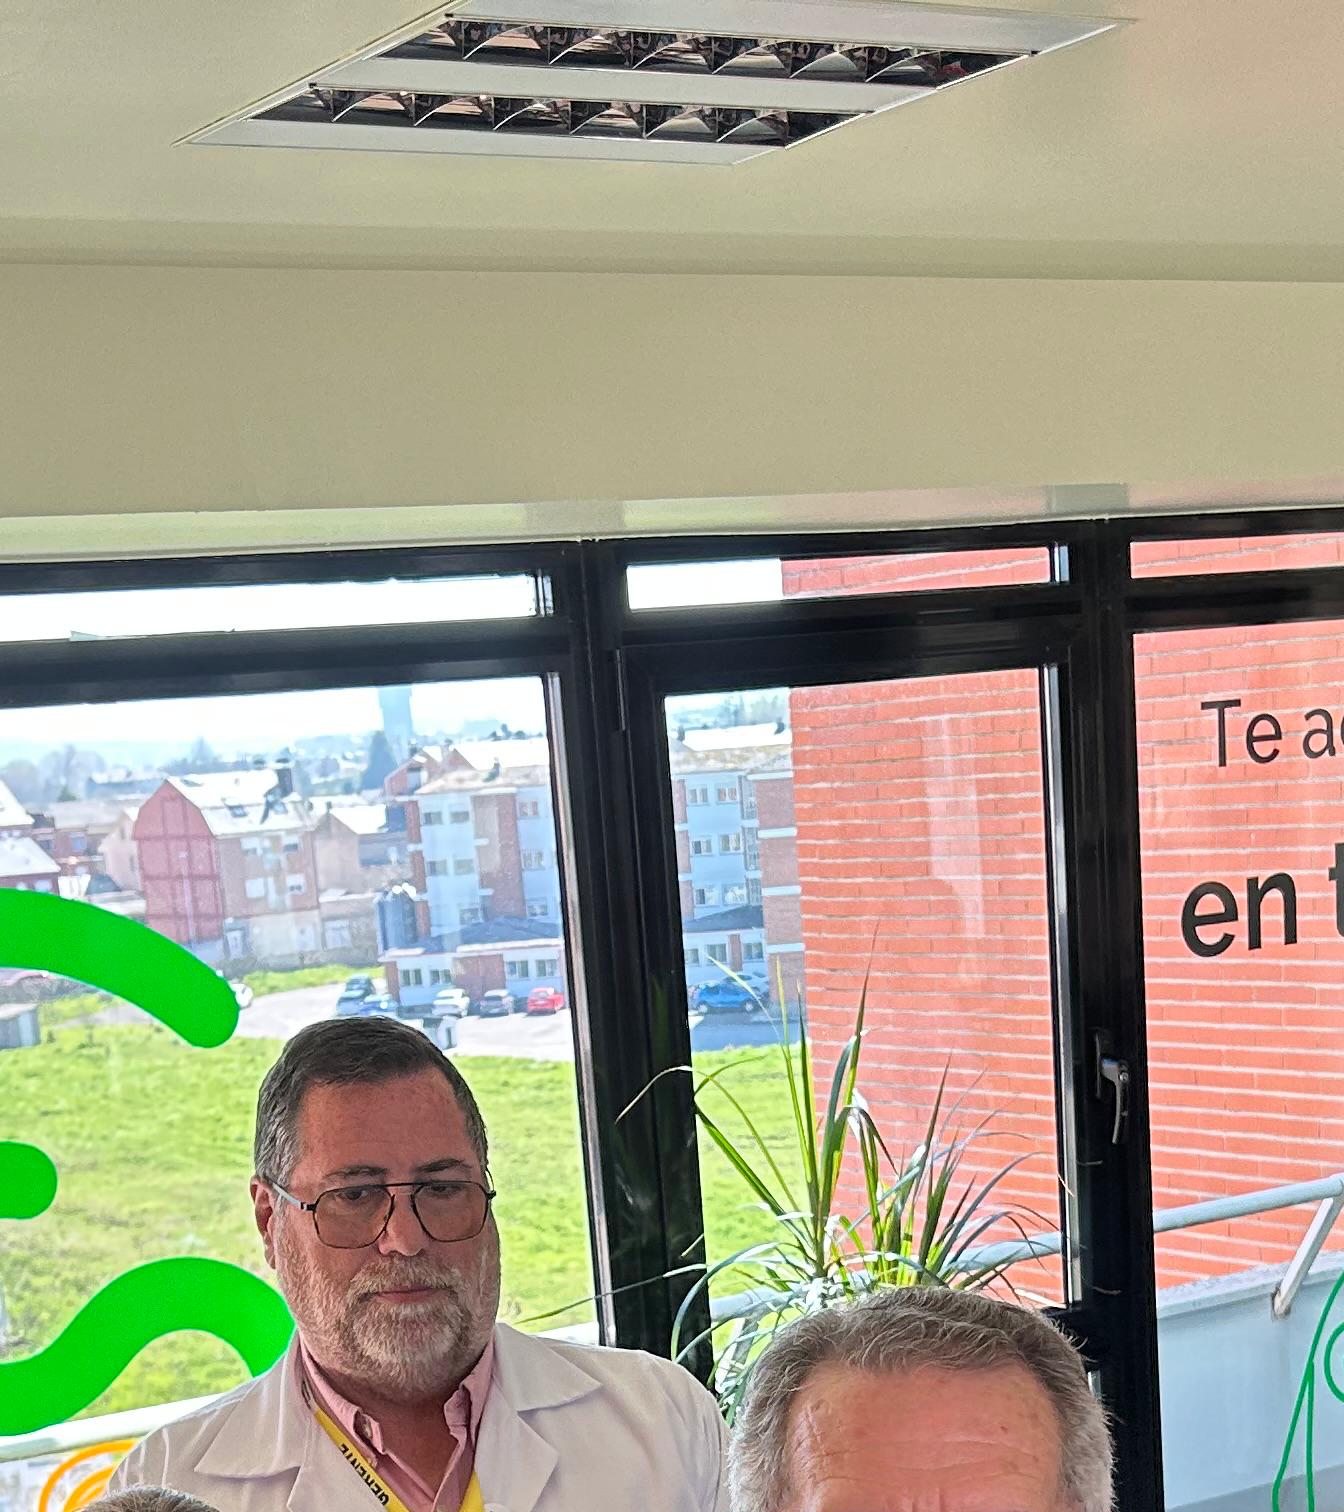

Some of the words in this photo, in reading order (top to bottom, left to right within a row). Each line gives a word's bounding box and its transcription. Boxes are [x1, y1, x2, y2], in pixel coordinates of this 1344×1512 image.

[1201, 698, 1283, 768] Te
[1180, 872, 1298, 958] en
[338, 1443, 390, 1507] GERENTE
